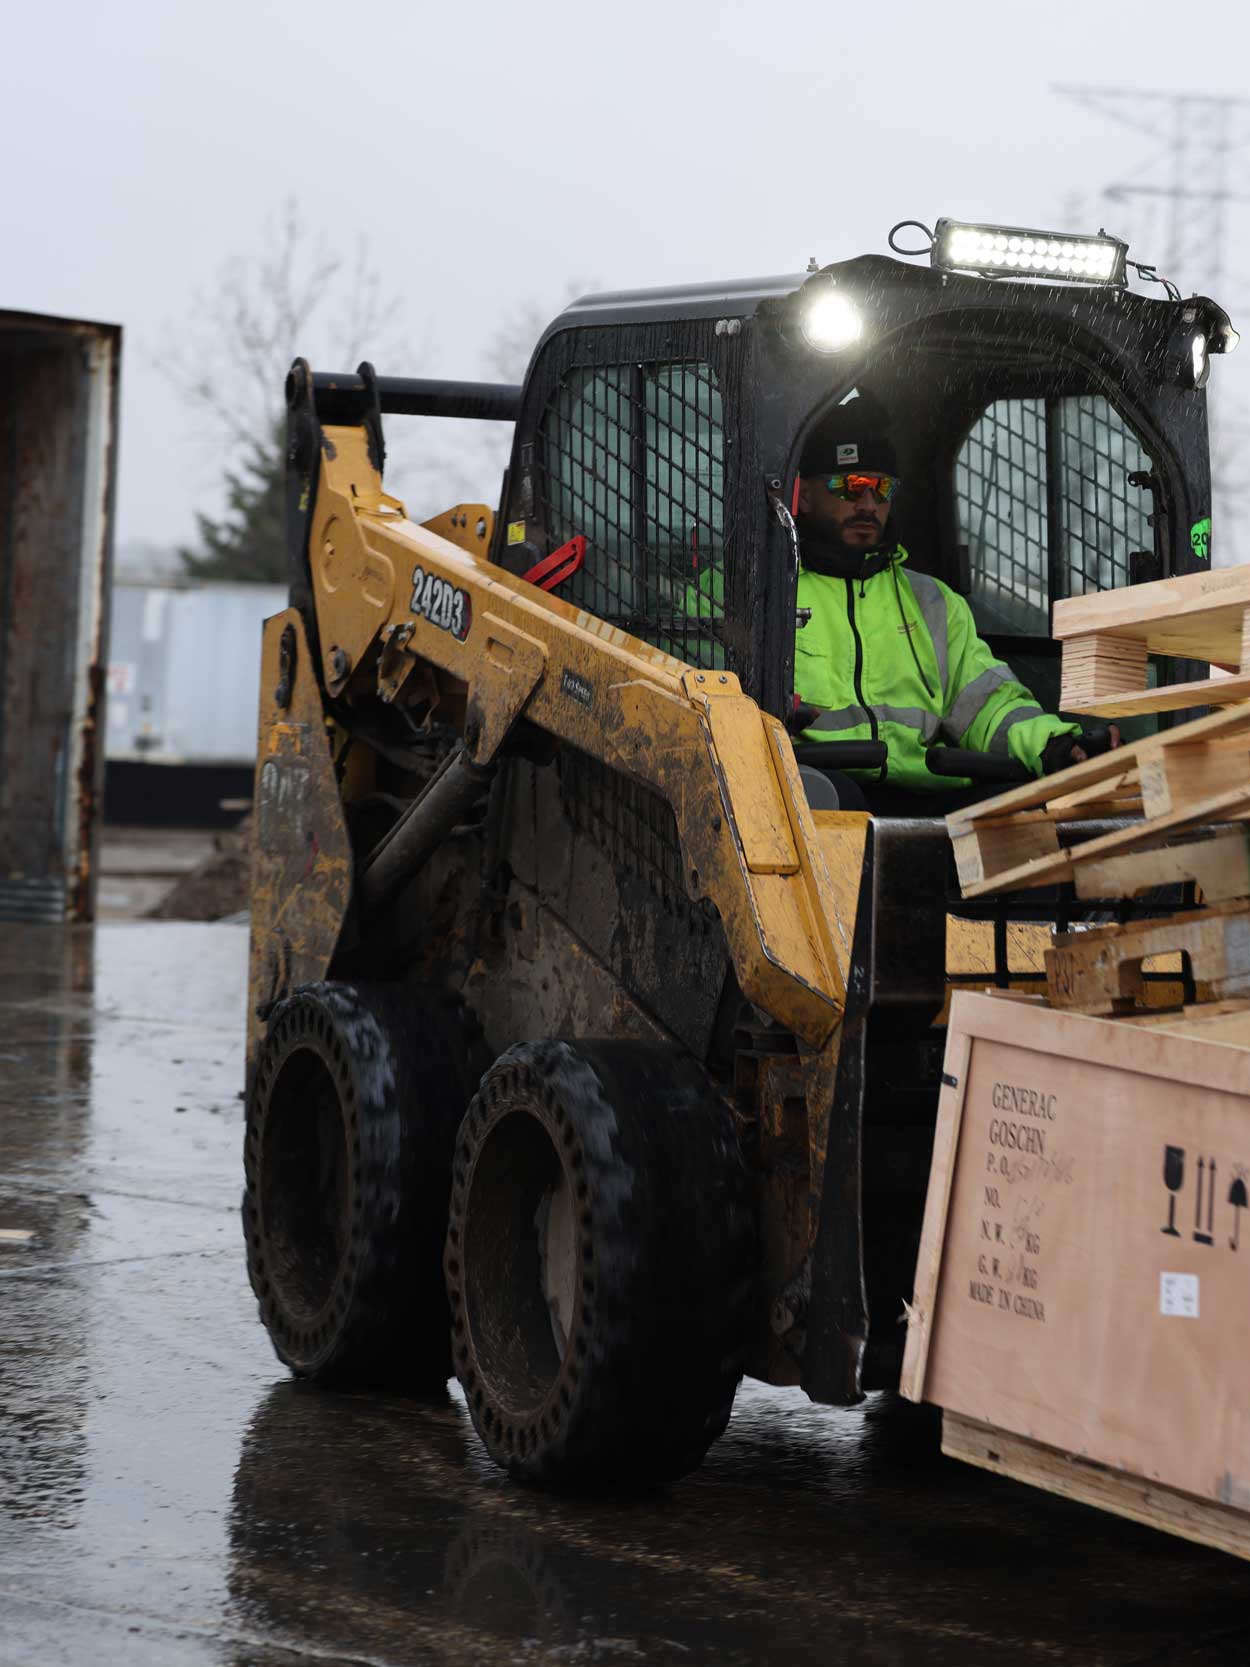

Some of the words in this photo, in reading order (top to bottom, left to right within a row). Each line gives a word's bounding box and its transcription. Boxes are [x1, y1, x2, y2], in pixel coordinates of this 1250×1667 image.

[410, 567, 465, 636] 242D3
[992, 1083, 1058, 1121] GENERAC
[998, 1287, 1011, 1311] IN
